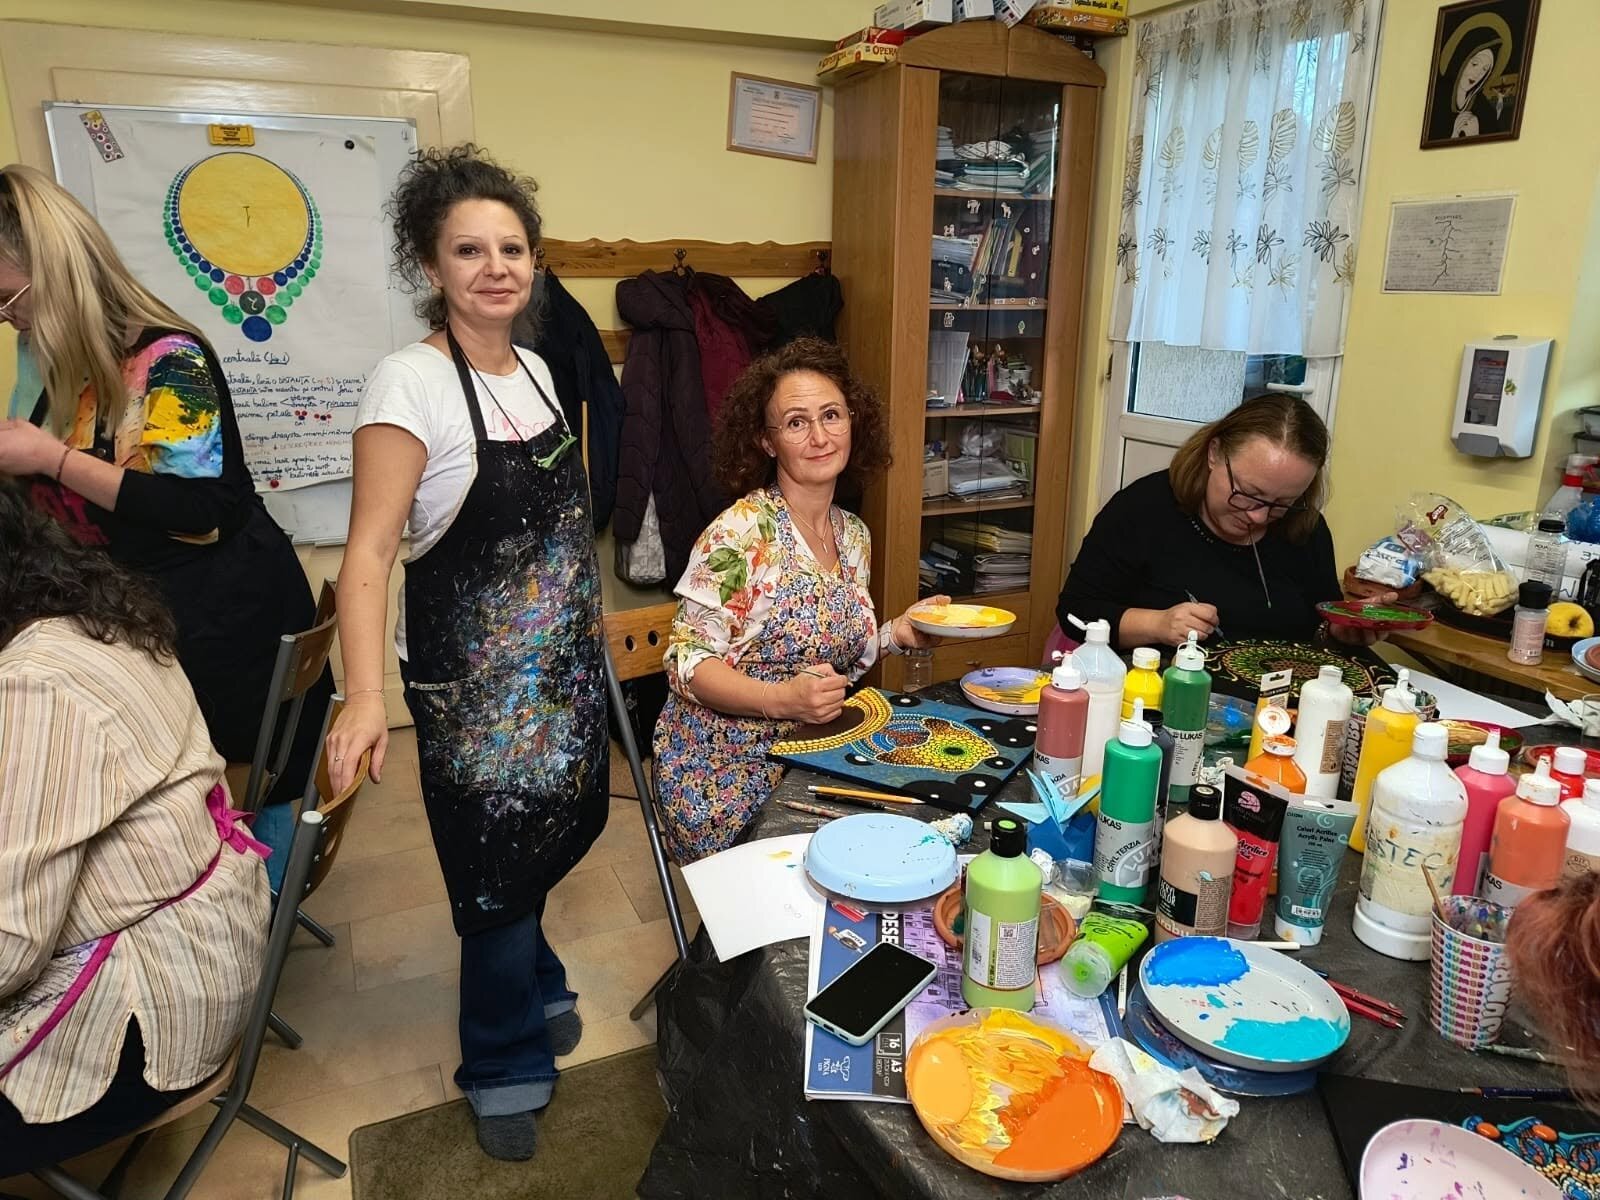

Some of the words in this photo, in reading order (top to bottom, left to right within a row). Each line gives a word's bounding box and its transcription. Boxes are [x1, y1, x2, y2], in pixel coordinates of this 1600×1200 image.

[1179, 731, 1204, 741] LUKAS
[1116, 839, 1142, 857] TERZIA
[1485, 872, 1503, 890] KAS
[881, 911, 900, 945] DESE
[889, 1037, 901, 1049] 16
[890, 1059, 903, 1073] A3
